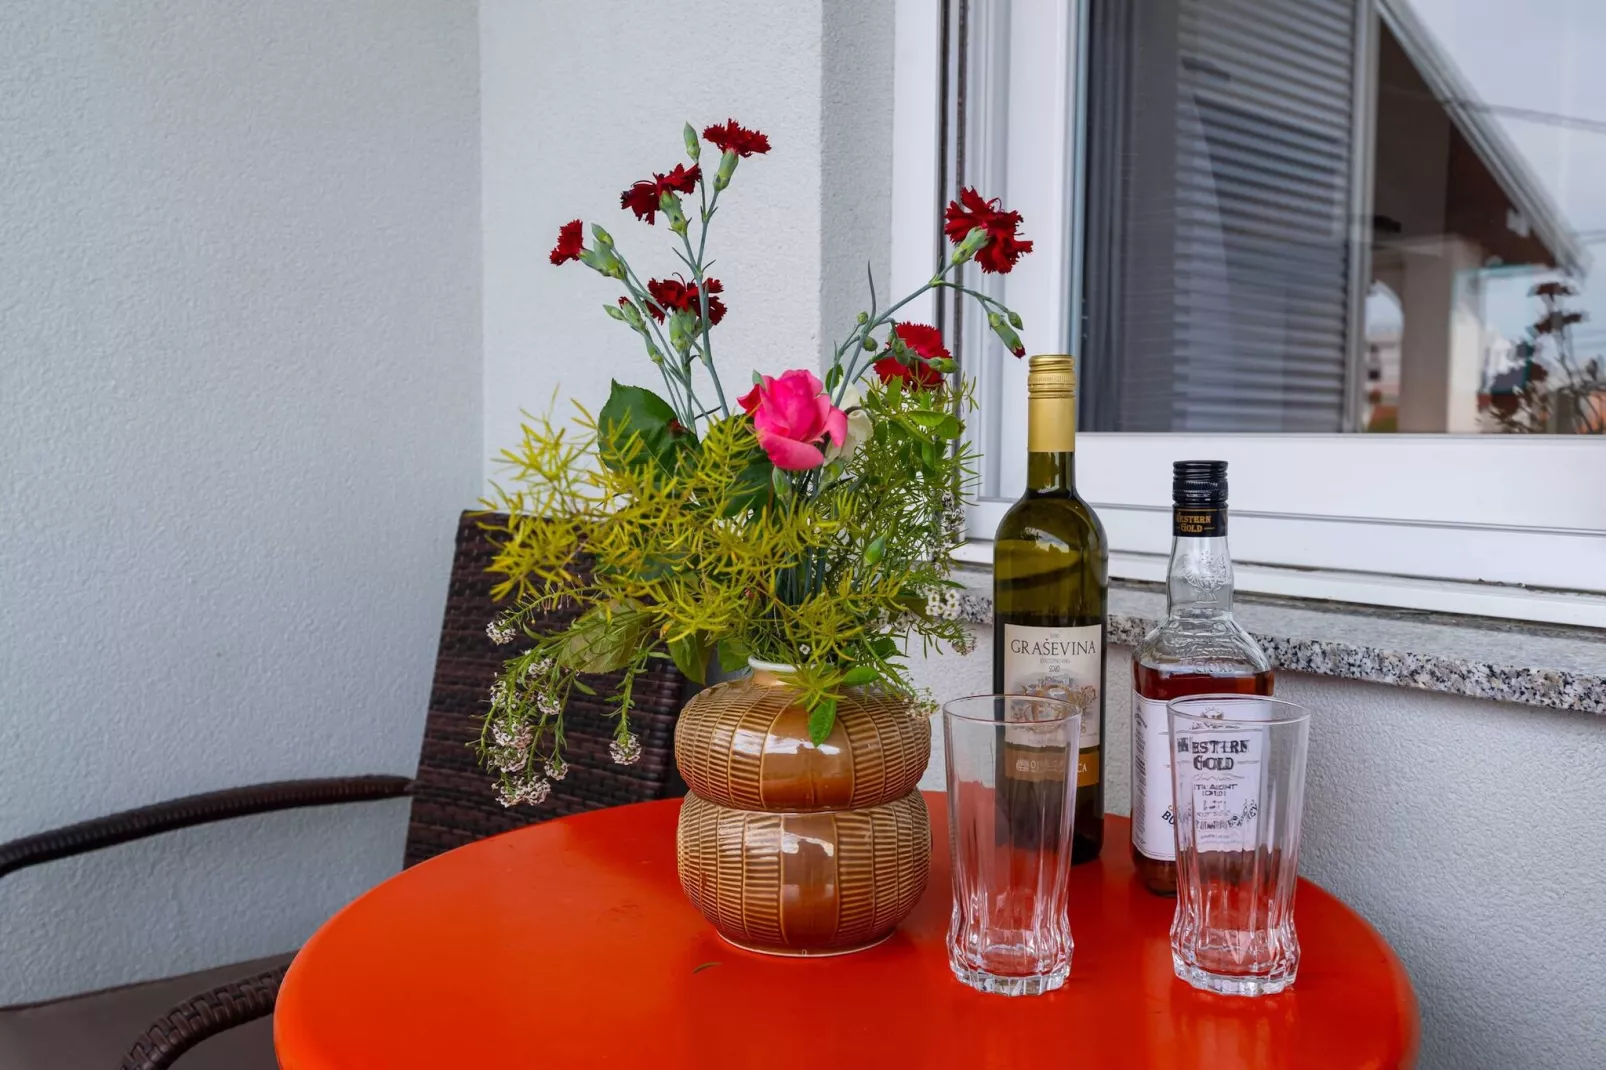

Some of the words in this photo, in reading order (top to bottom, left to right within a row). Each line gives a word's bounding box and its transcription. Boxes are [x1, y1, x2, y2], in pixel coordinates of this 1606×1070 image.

[1176, 511, 1212, 524] WESTERN
[1180, 523, 1203, 533] GOLD
[1010, 638, 1096, 656] GRAŠEVINA
[1193, 755, 1234, 771] GOLD
